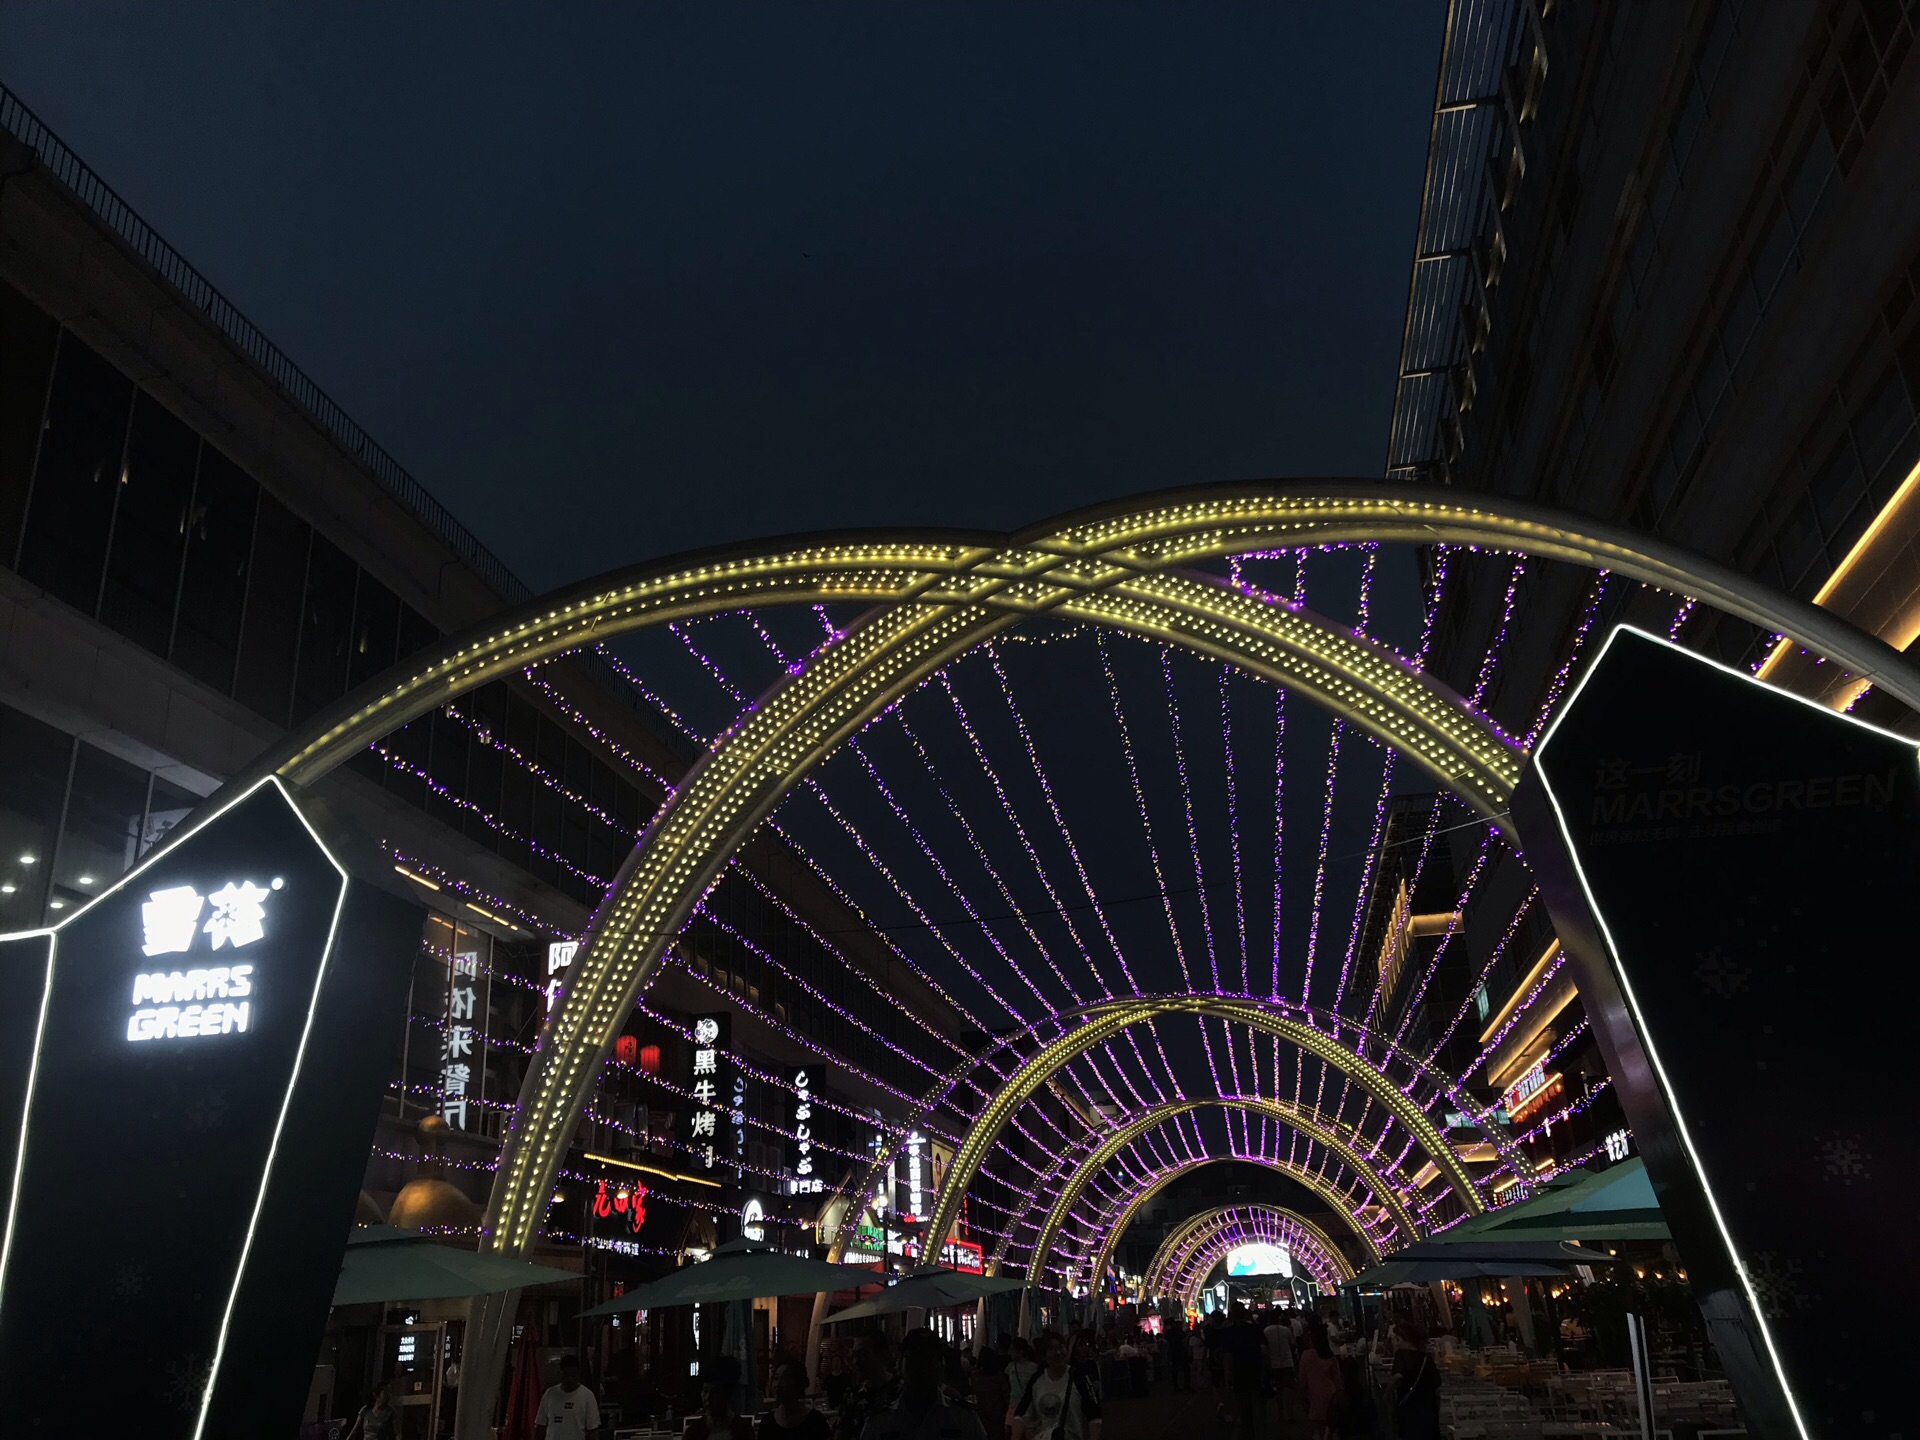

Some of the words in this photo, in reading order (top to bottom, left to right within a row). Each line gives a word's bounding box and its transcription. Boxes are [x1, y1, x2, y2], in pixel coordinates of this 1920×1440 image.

[1594, 751, 1703, 790] 这一刻
[1591, 767, 1898, 825] MARRSGREEN
[132, 965, 253, 1005] MARRS
[127, 1001, 249, 1042] GREEN
[795, 1070, 813, 1175] しゃぶしゃぶ
